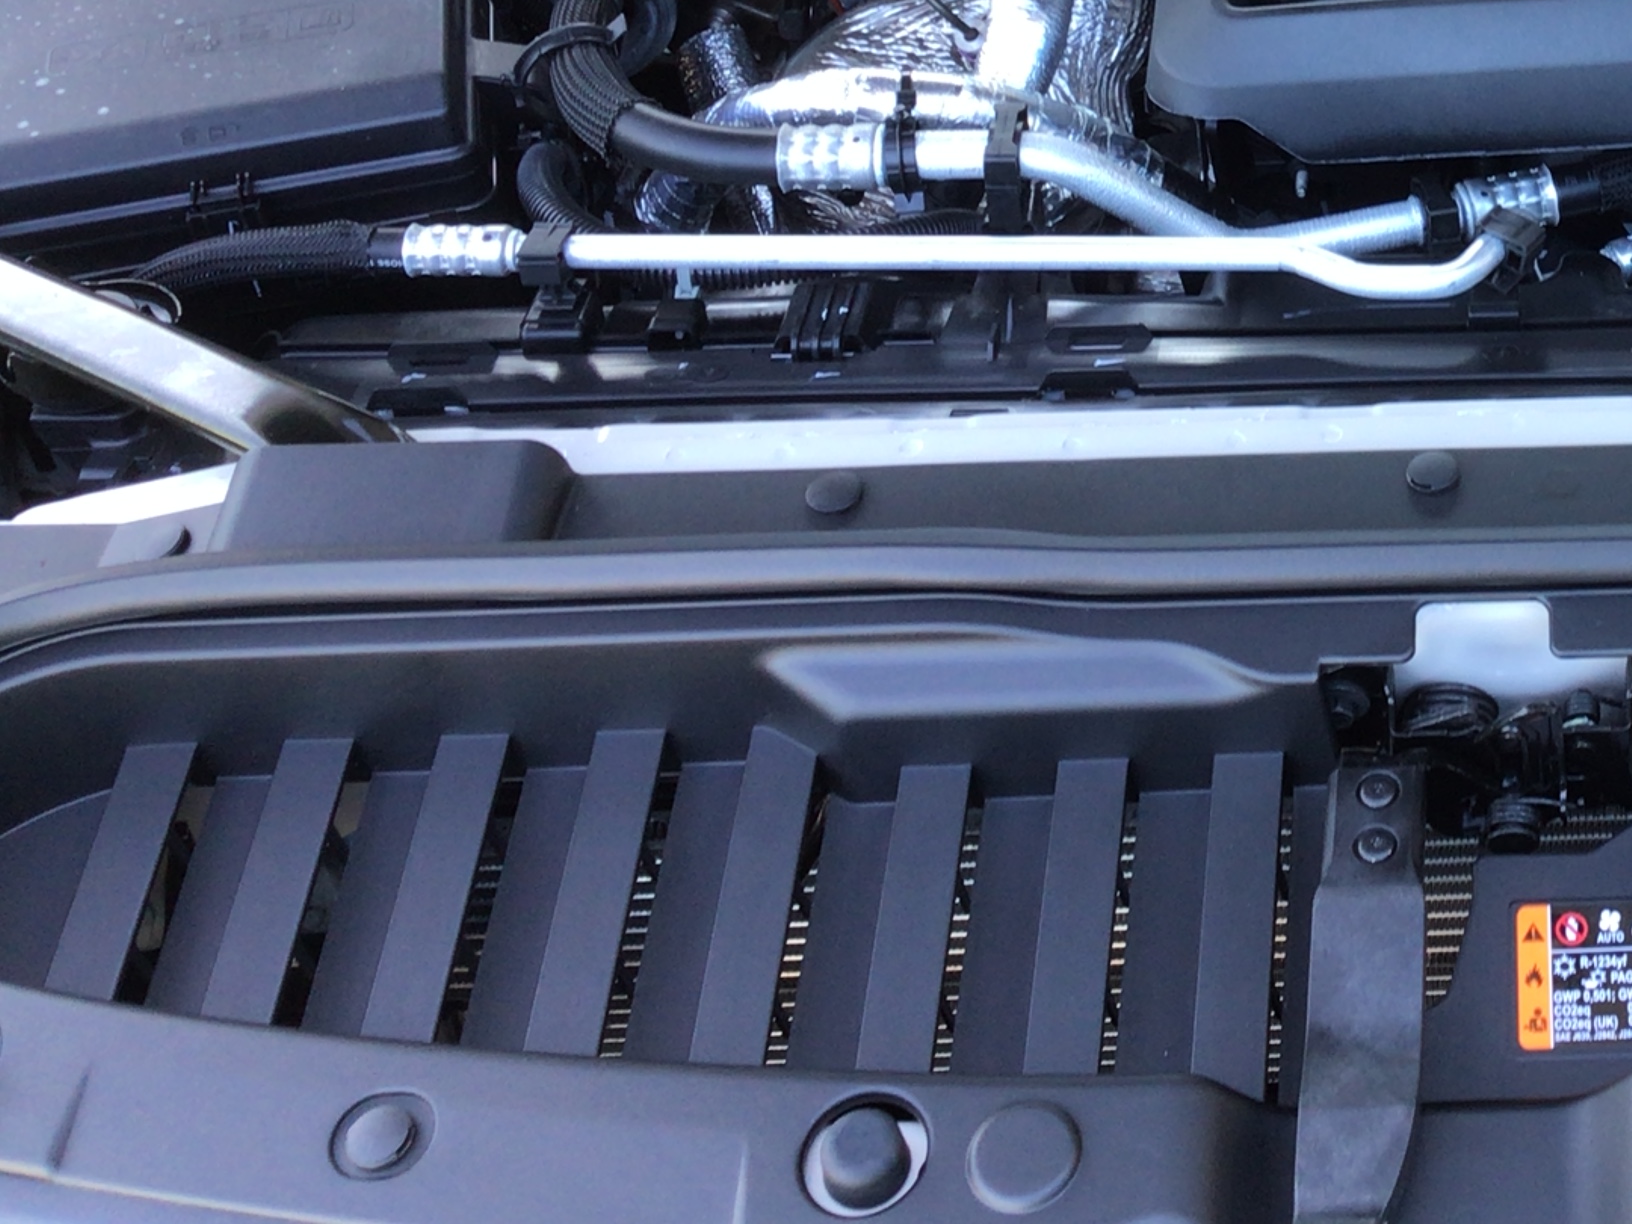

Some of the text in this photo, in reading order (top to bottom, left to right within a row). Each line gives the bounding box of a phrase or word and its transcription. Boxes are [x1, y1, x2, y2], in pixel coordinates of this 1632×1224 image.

[1596, 930, 1625, 944] AUTO
[1580, 953, 1627, 970] R-1234yf
[1554, 989, 1581, 1004] GWP
[1594, 1014, 1619, 1032] (UK)
